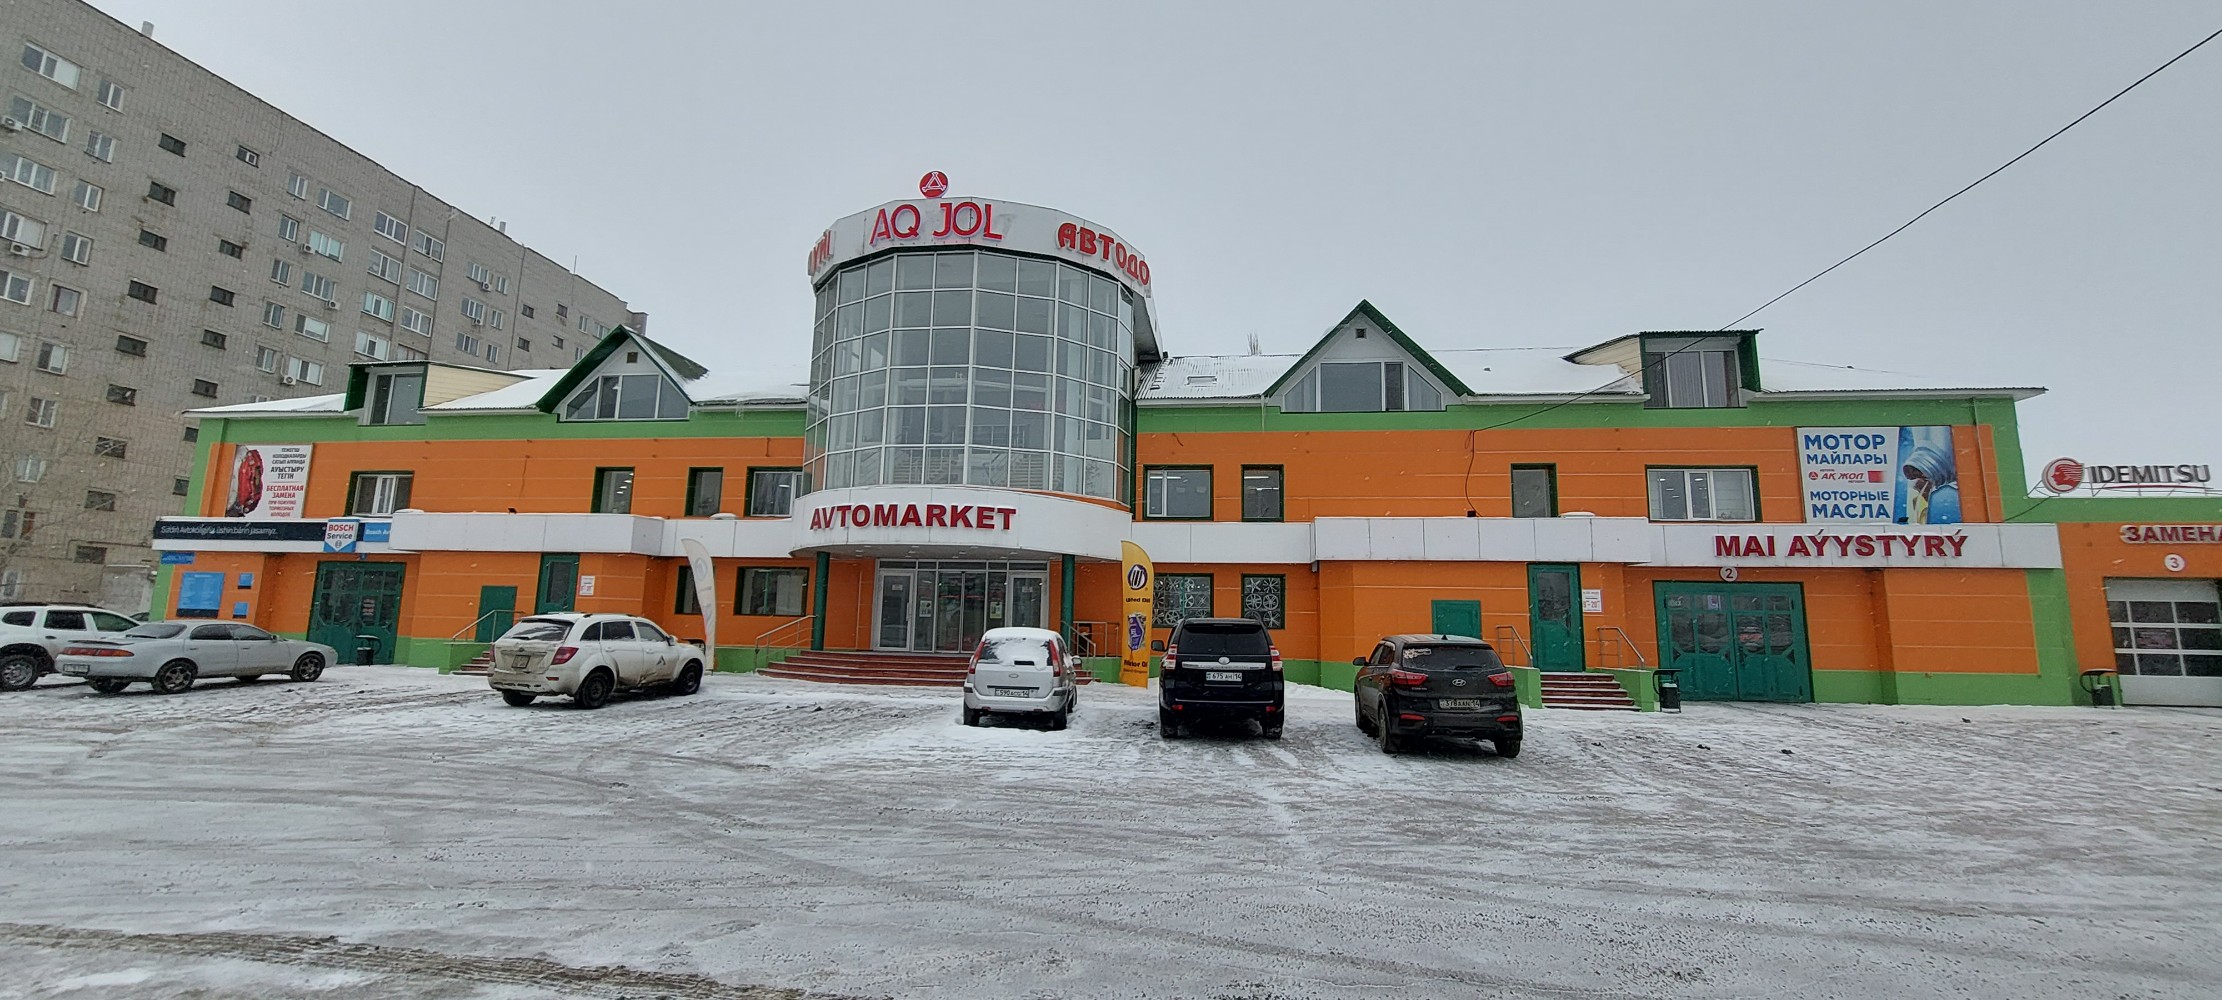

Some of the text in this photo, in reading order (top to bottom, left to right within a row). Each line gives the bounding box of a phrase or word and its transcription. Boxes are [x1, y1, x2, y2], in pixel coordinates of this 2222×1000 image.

[869, 201, 1003, 245] AQ JOL
[1057, 222, 1150, 286] АВТОДО
[1804, 434, 1885, 450] МОТОР
[1806, 451, 1887, 465] МАЙЛАРЫ
[1838, 472, 1864, 480] ЖОЛ
[2089, 464, 2211, 484] IDEMITSU
[1810, 491, 1890, 501] МОТОРНЫЕ
[809, 504, 1017, 531] AVTOMARKET
[1811, 503, 1891, 518] МАСЛА
[328, 524, 354, 532] BOSCH
[2125, 526, 2222, 542] ЗАМЕН
[327, 532, 353, 540] Service
[1714, 529, 1969, 557] MAI AÝYSTYRÝ
[2170, 557, 2179, 569] 3
[1725, 568, 1734, 579] 2
